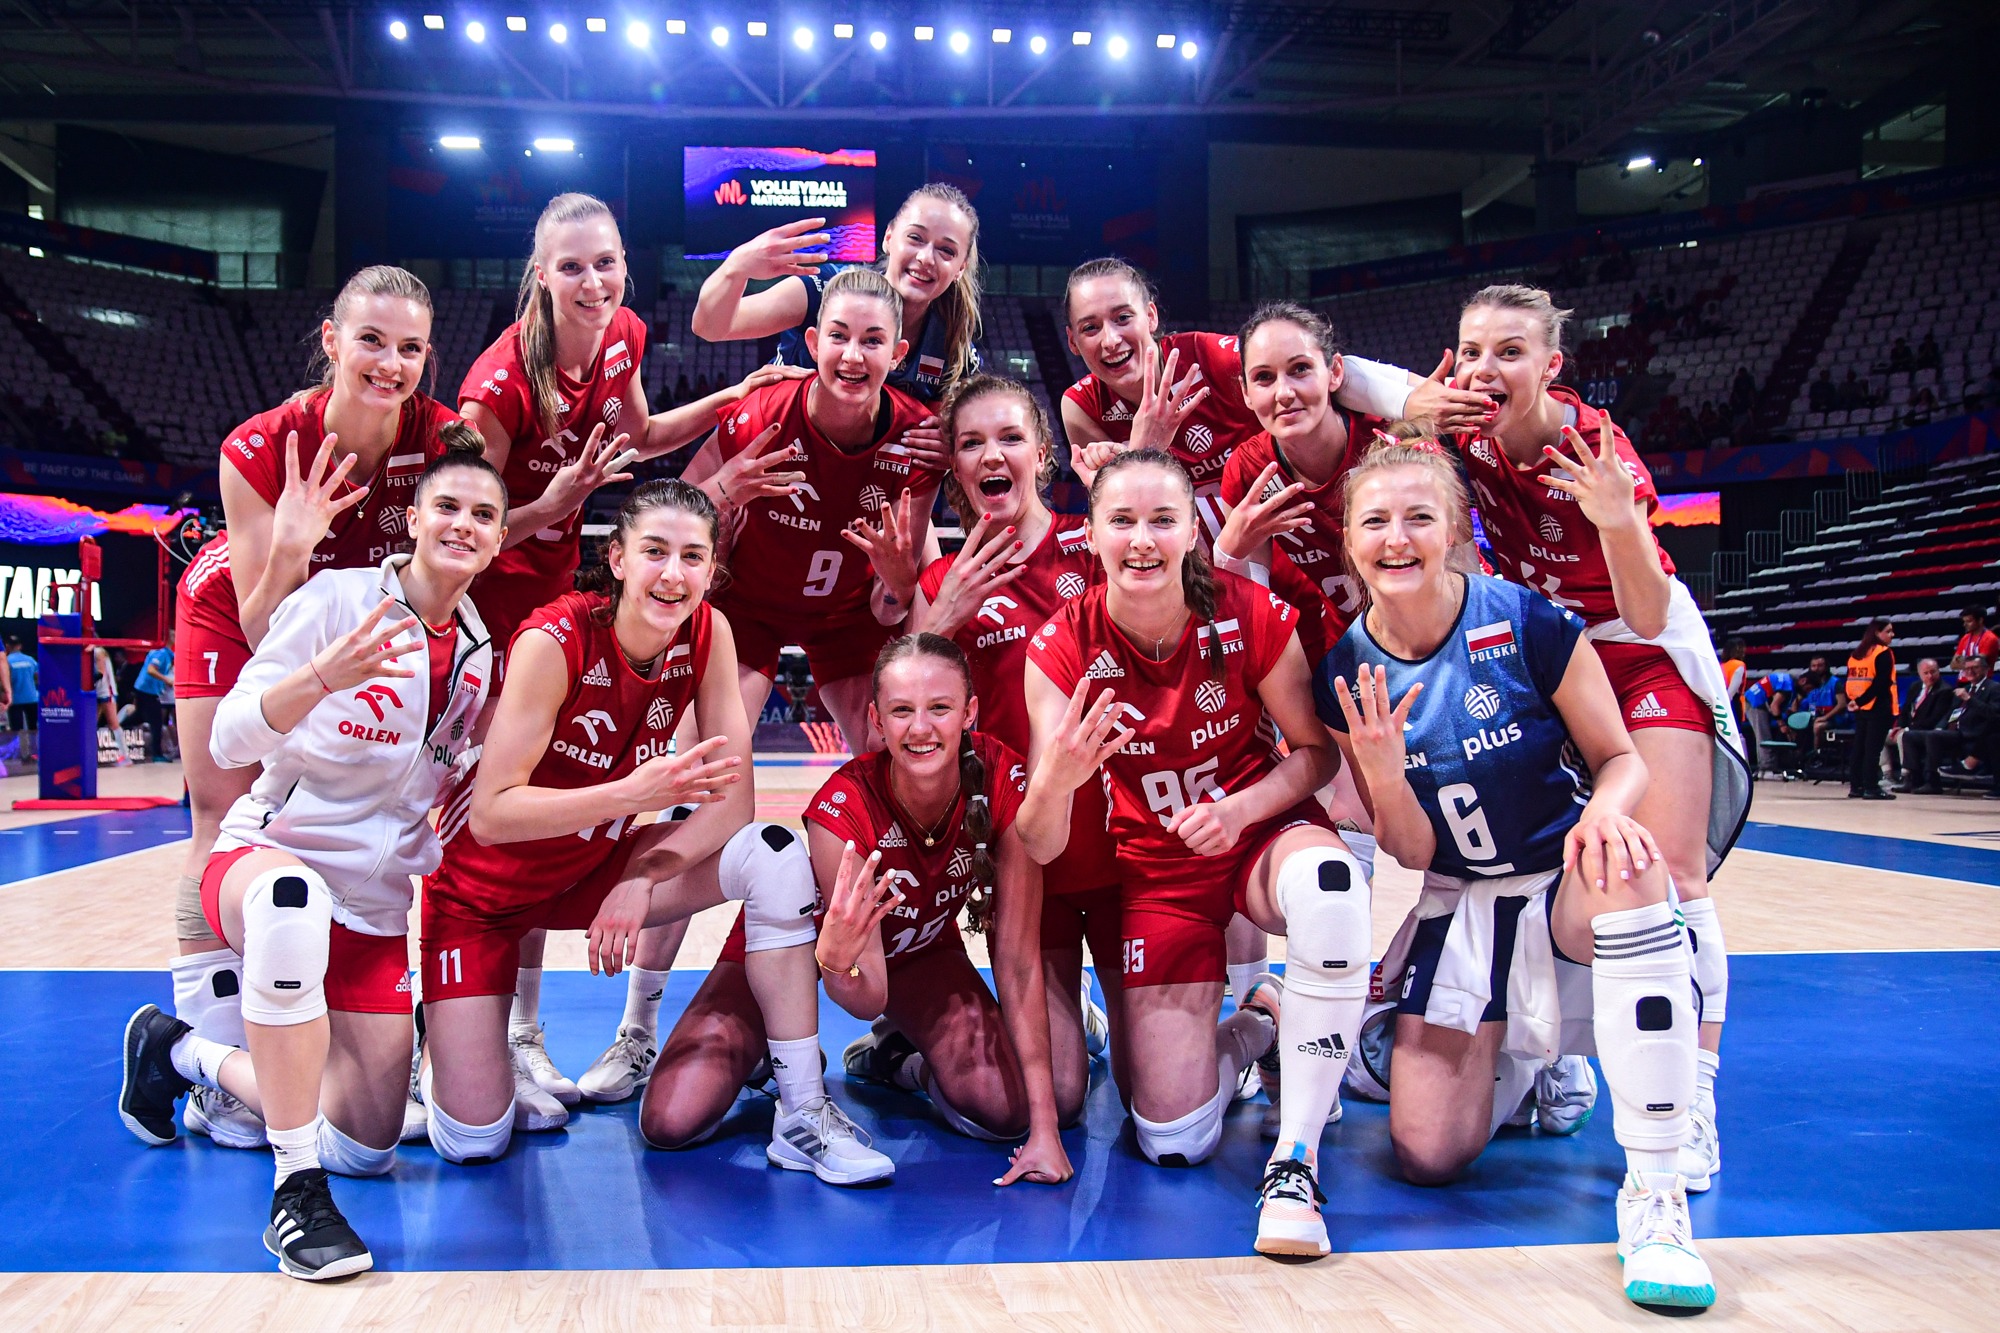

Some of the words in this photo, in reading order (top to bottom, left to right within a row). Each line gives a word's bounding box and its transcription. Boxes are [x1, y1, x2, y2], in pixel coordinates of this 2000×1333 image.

[751, 179, 847, 196] VOLLEYBALL
[751, 194, 801, 207] NATIONS
[803, 194, 847, 207] LEAGUE
[604, 358, 632, 381] POLSKA
[481, 378, 502, 396] plus
[1587, 380, 1618, 405] 209
[231, 437, 255, 460] plus
[1469, 443, 1498, 468] adidas
[40, 463, 68, 477] PART
[71, 467, 86, 477] OF
[90, 469, 110, 480] THE
[113, 470, 144, 484] GAME
[874, 460, 910, 475] POLSKA
[768, 510, 822, 532] ORLEN
[1288, 549, 1330, 564] RLEN
[803, 550, 844, 597] 9
[541, 621, 567, 644] plus
[976, 625, 1027, 649] ORLEN
[1030, 634, 1047, 651] plus
[1469, 643, 1518, 665] POLSKA
[203, 651, 219, 685] 7
[660, 665, 693, 683] POLSKA
[1085, 666, 1125, 680] adidas
[582, 674, 612, 688] adidas
[1630, 707, 1667, 719] adidas
[338, 720, 402, 746] ORLEN
[1190, 713, 1241, 750] plus
[1462, 722, 1523, 761] plus
[553, 740, 614, 770] ORLEN
[818, 800, 841, 818] plus
[1437, 783, 1498, 861] 6
[878, 837, 908, 848] adidas
[935, 876, 978, 907] plus
[439, 948, 463, 985] 11
[1401, 964, 1417, 999] 6
[1297, 1041, 1349, 1060] adidas
